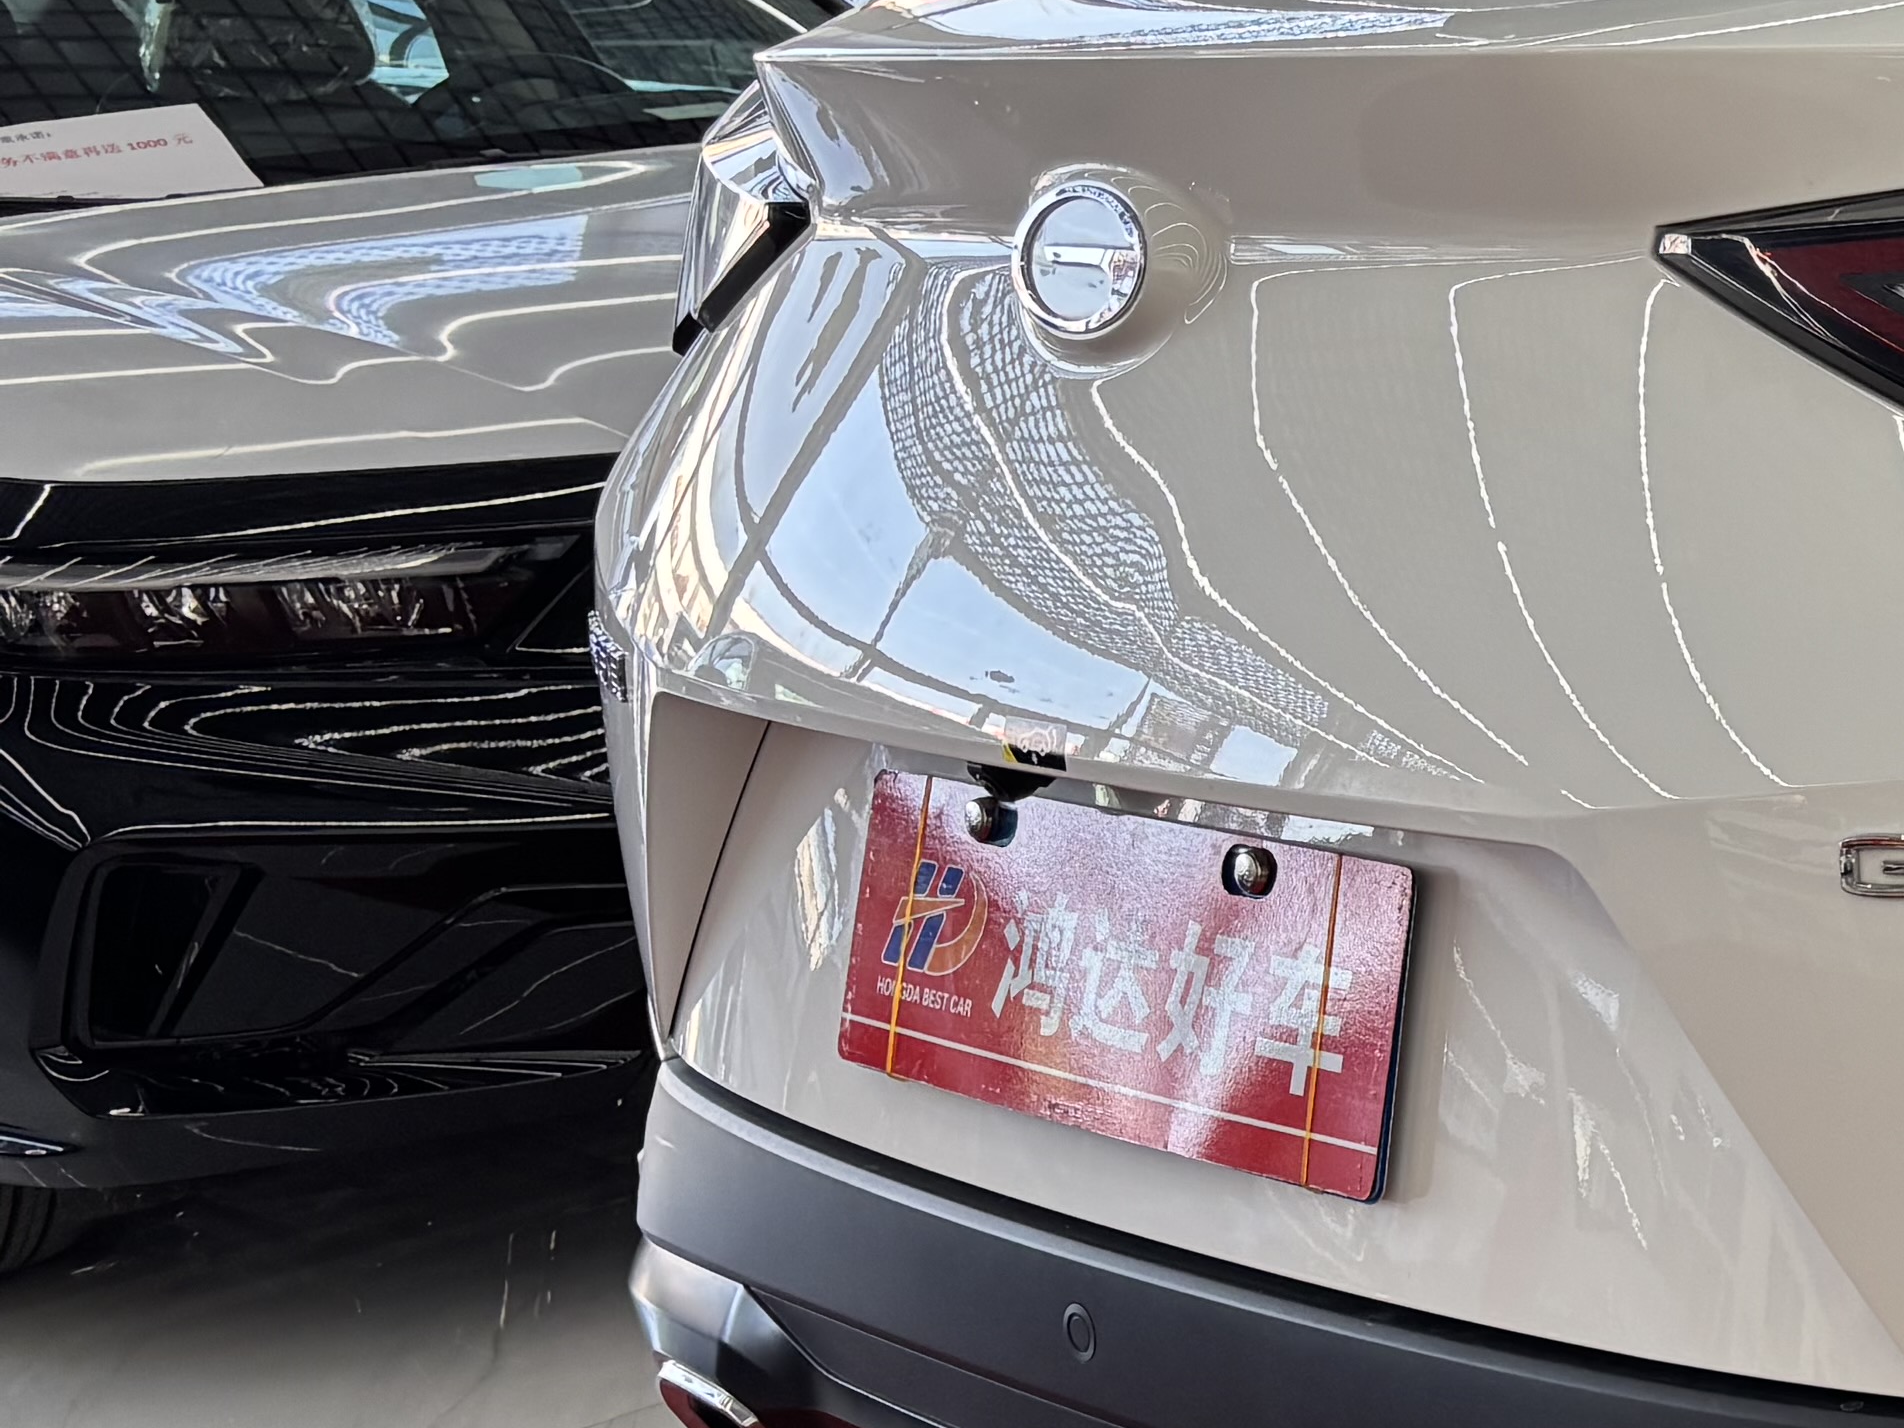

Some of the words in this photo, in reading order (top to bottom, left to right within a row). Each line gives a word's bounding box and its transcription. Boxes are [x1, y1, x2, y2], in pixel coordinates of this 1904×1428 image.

[127, 138, 168, 152] 1000
[175, 133, 193, 147] 元
[876, 974, 920, 1005] HOGDA
[921, 987, 950, 1012] BEST
[949, 994, 973, 1019] CAR
[991, 890, 1353, 1097] 鸿达好车
